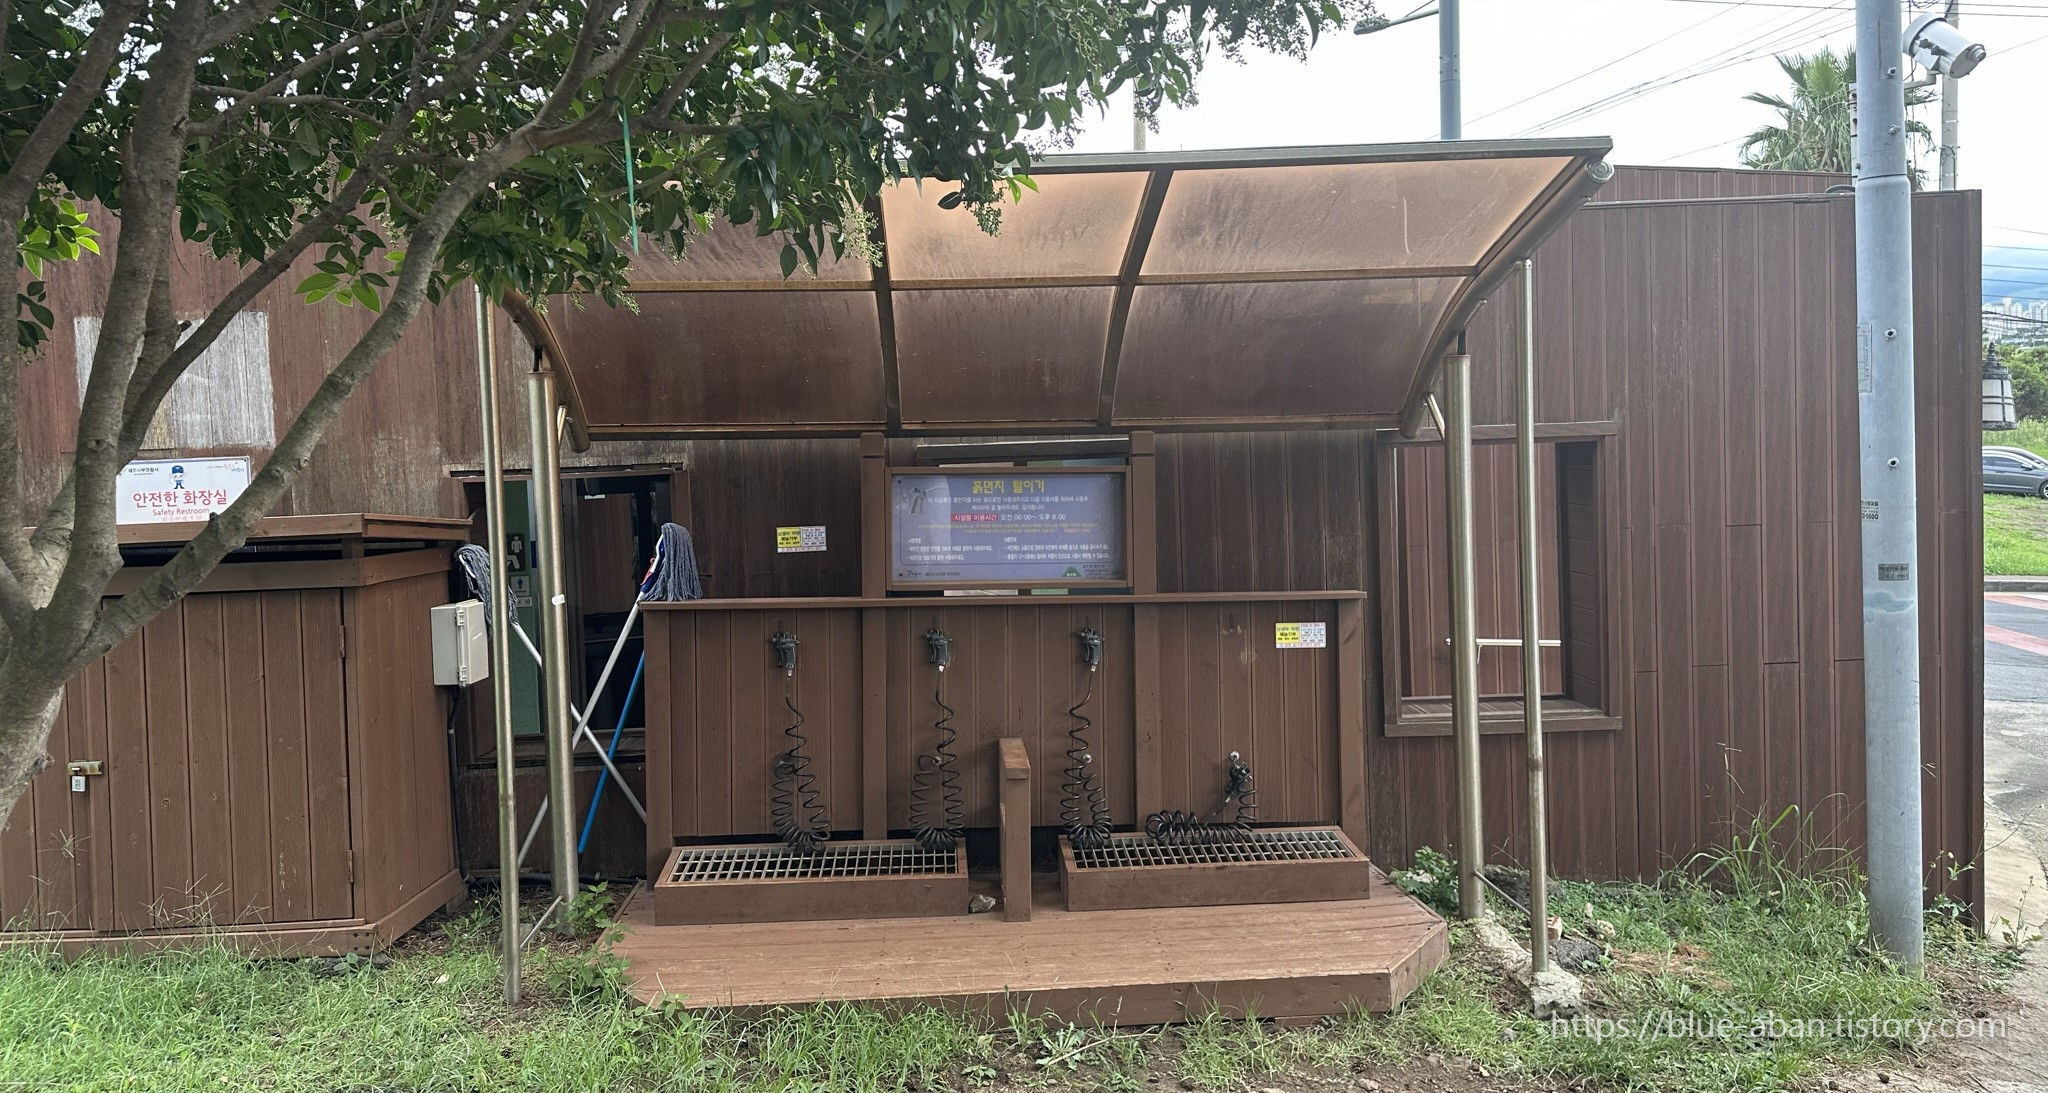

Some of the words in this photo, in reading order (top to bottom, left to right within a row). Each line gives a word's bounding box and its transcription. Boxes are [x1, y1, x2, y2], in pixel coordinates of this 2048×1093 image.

[972, 480, 1004, 494] 흙먼지
[1013, 480, 1044, 494] 털이기
[133, 491, 178, 508] 안전한
[183, 489, 228, 506] 화장실
[152, 509, 175, 517] Safety
[955, 514, 973, 522] 시설물
